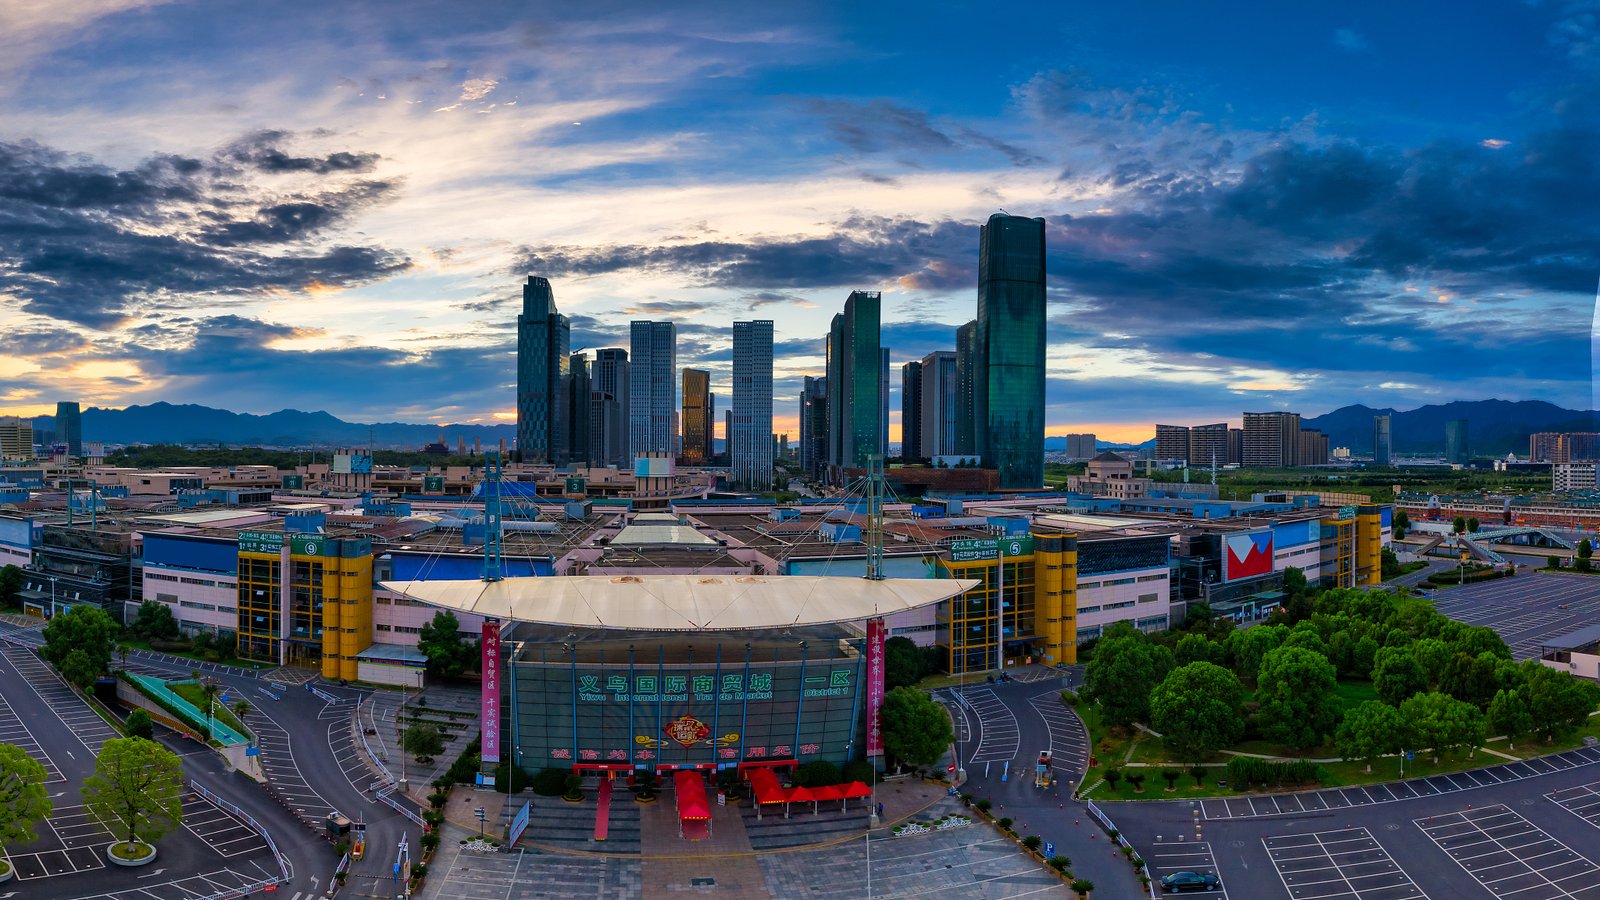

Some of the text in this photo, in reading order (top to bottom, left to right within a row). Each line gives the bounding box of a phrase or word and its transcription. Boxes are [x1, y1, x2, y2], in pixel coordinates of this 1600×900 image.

[579, 670, 851, 693] 义乌国际商贸城 一区
[579, 693, 606, 701] Yiwu
[805, 687, 841, 697] District
[718, 743, 820, 758] 信用无价
